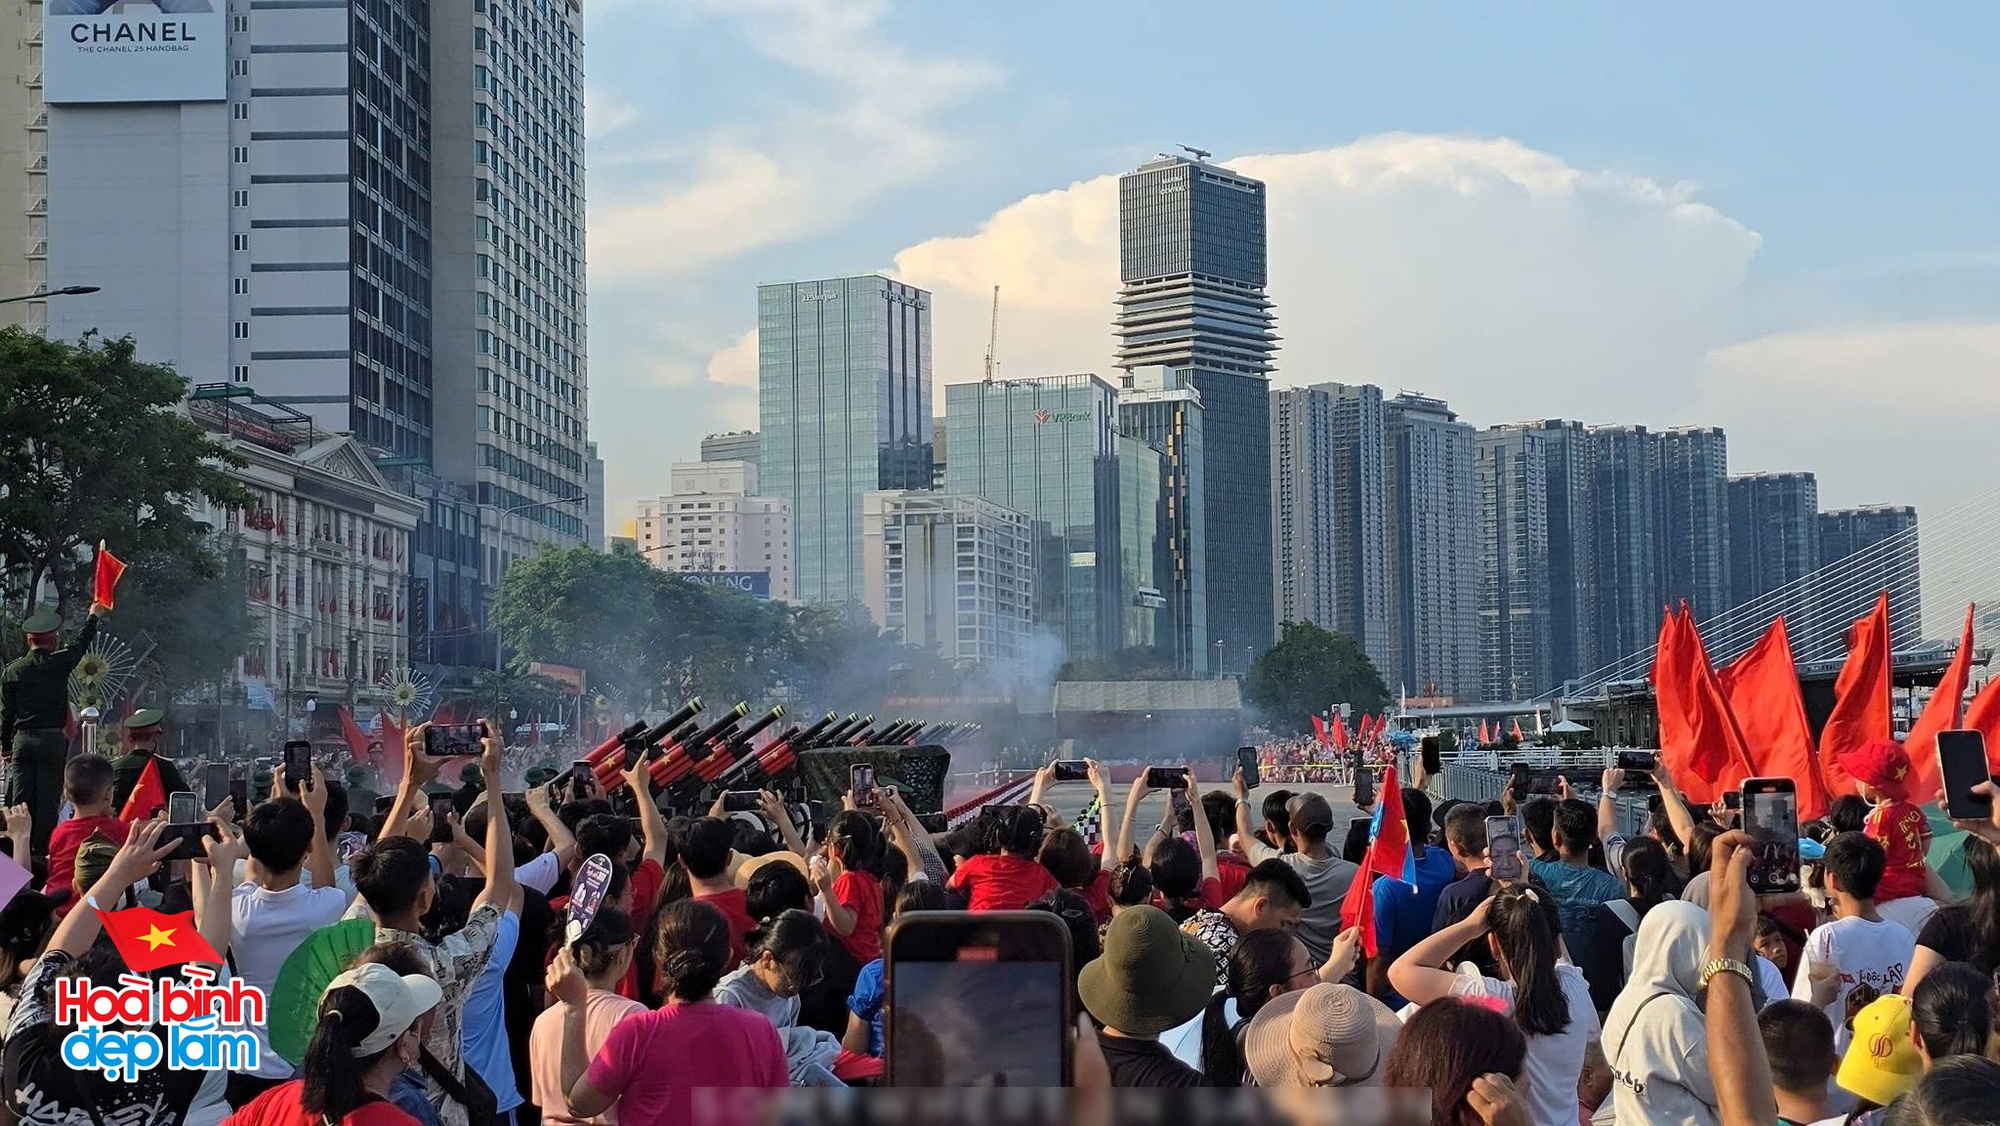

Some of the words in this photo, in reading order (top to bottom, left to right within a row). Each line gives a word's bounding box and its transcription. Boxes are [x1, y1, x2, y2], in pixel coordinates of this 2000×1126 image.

[70, 22, 197, 43] CHANEL
[96, 45, 132, 53] CHANEL
[146, 44, 189, 52] HANDBAG
